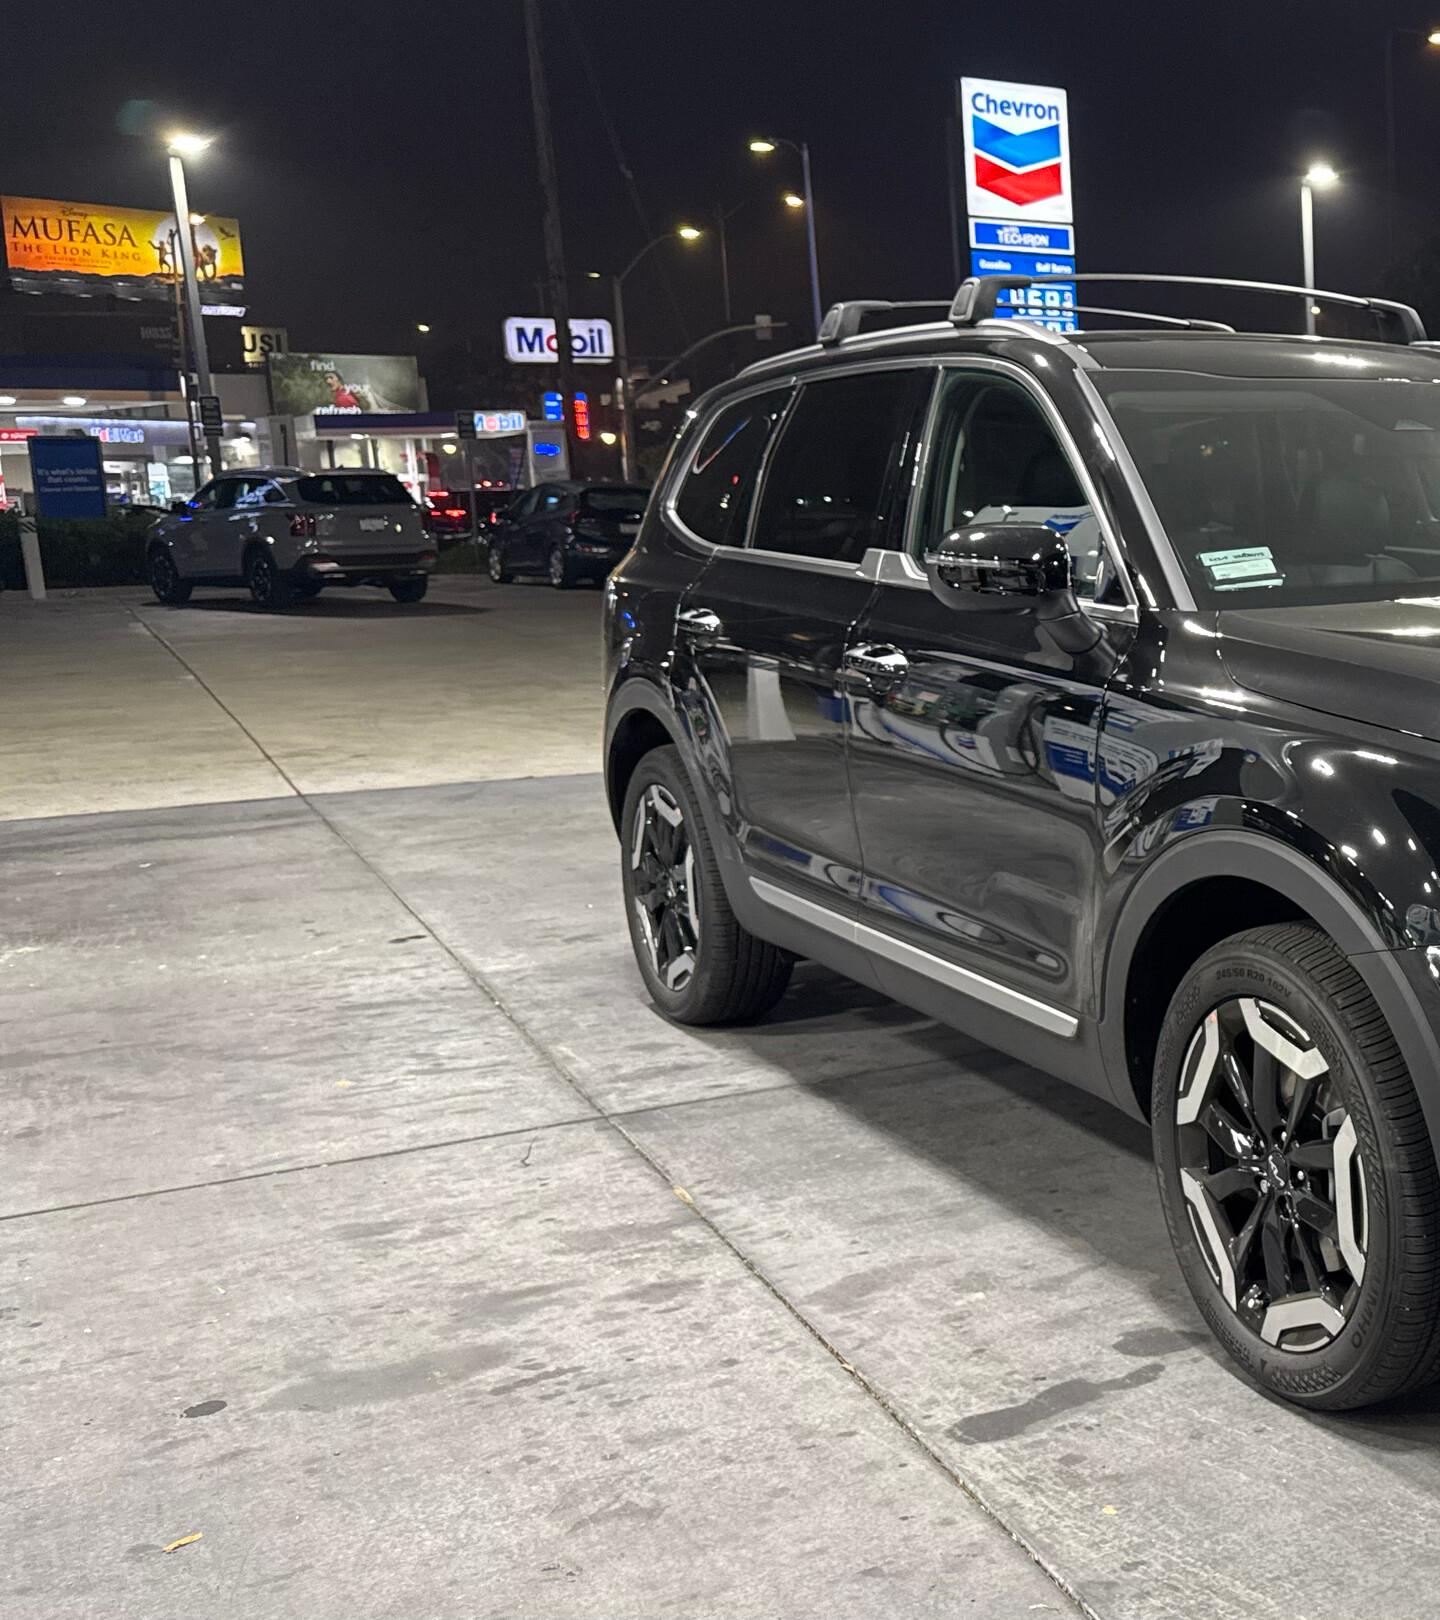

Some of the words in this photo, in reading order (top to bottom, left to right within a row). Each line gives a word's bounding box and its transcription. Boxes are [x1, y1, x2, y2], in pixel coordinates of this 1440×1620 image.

[971, 91, 1061, 122] Chevron
[12, 215, 140, 248] MUFASA
[996, 229, 1050, 247] TECHRON
[10, 241, 43, 254] THE
[53, 244, 92, 257] LION
[101, 248, 142, 262] KING
[310, 360, 336, 372] find
[343, 382, 371, 395] your
[315, 404, 362, 416] refresh
[474, 413, 523, 431] Mobil
